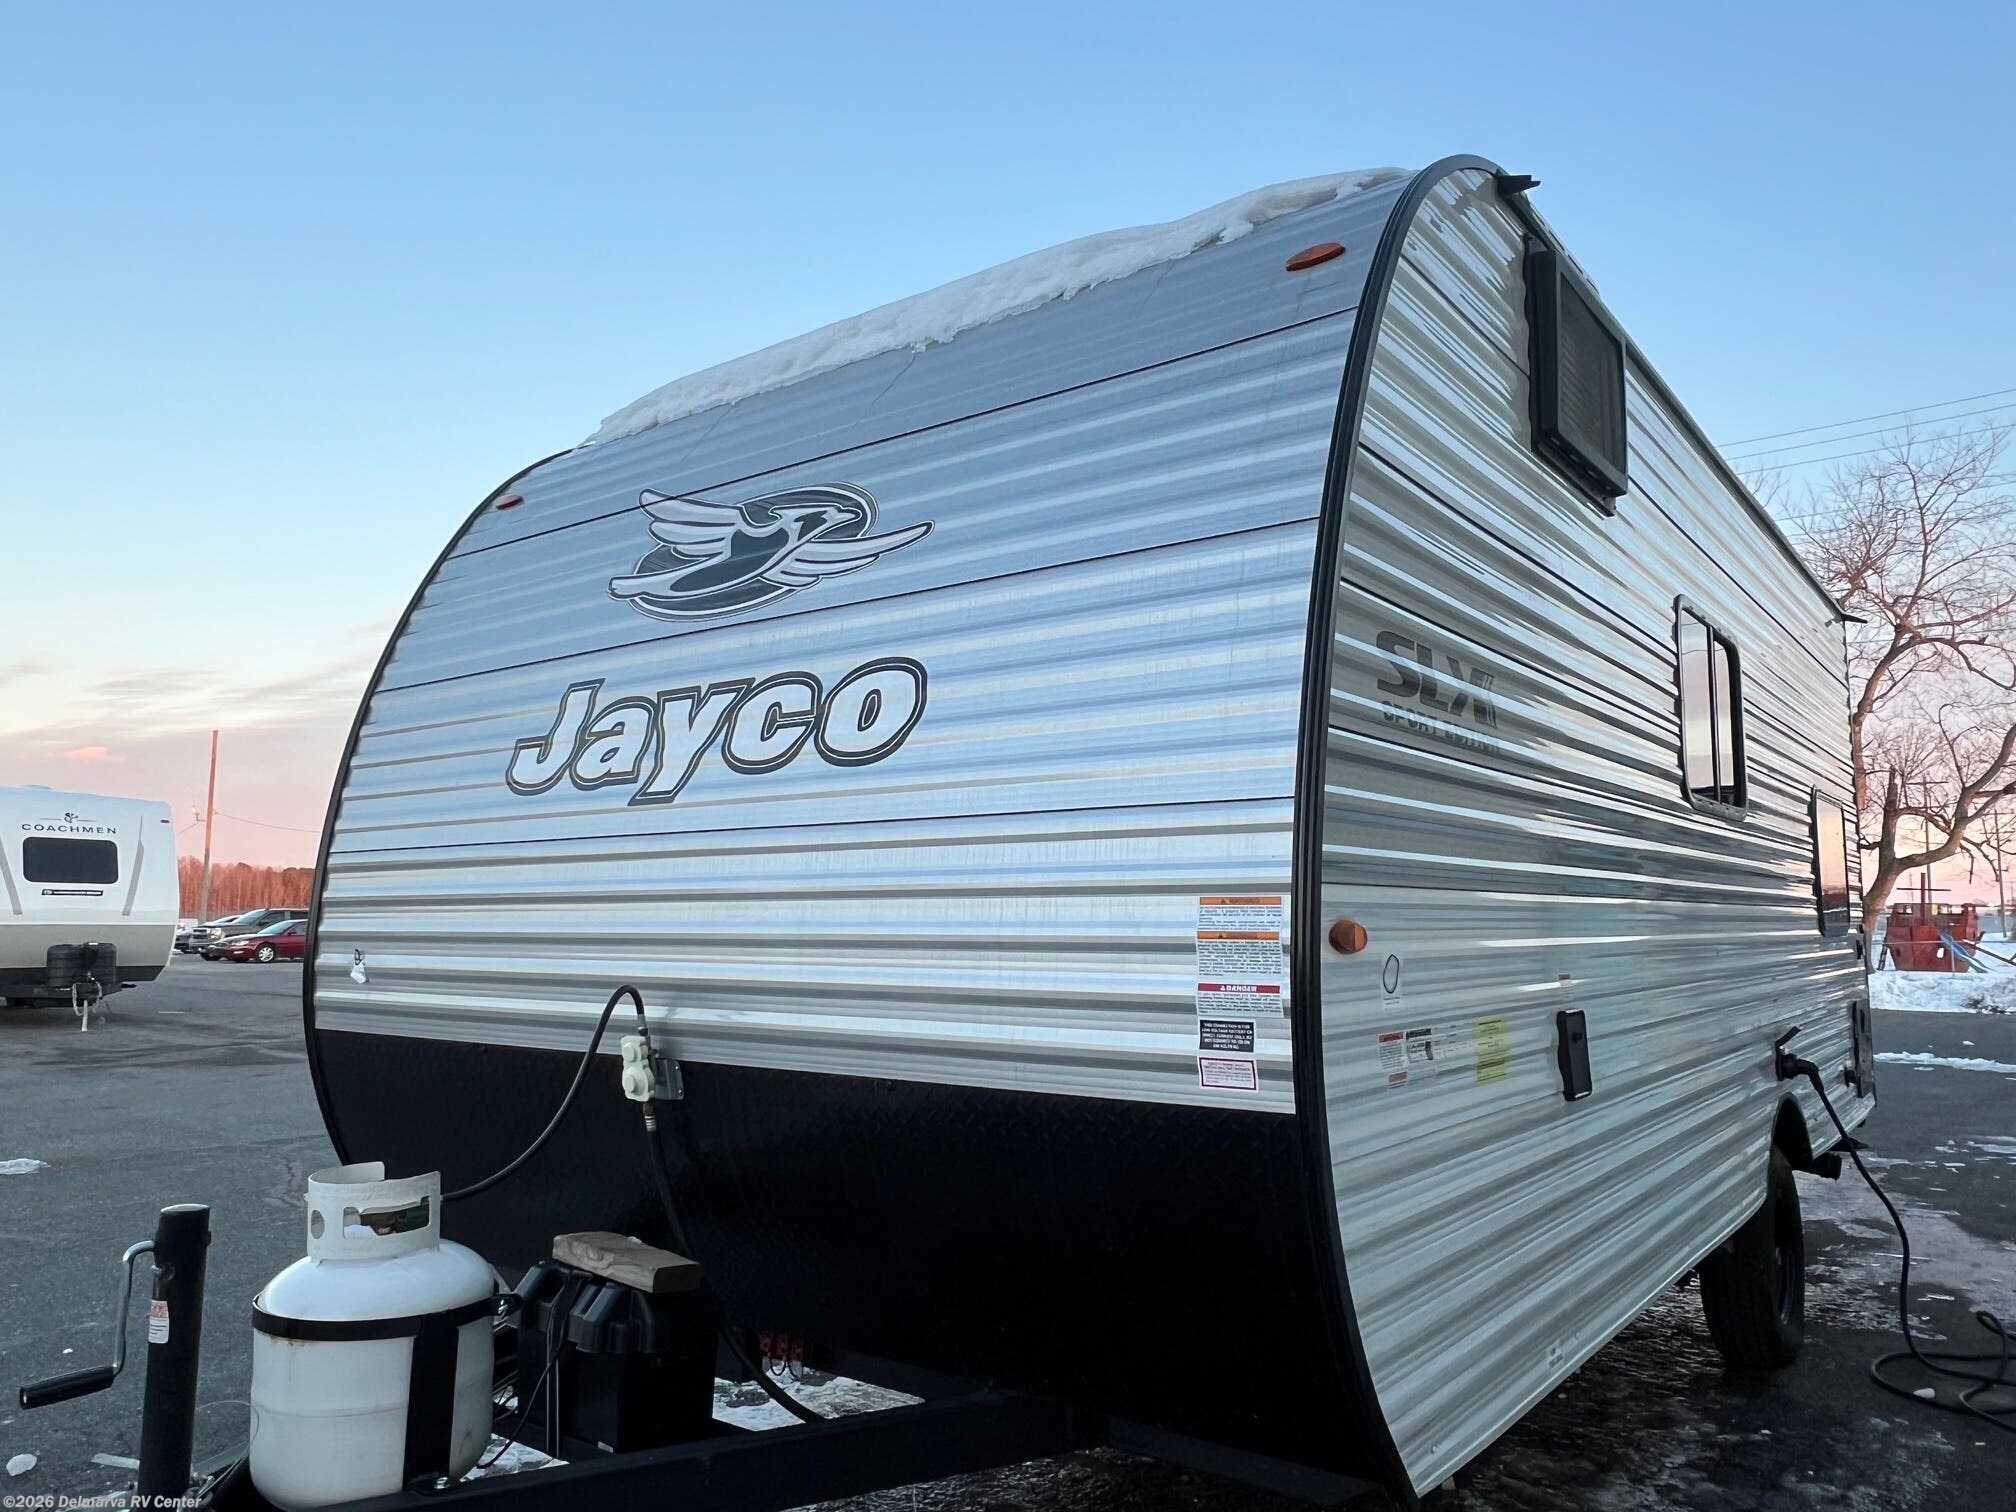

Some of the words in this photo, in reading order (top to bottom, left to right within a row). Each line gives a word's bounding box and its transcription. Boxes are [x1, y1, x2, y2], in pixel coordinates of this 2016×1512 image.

[1376, 630, 1498, 730] SLX
[504, 656, 928, 806] Jayco
[21, 823, 117, 834] COACHMEN
